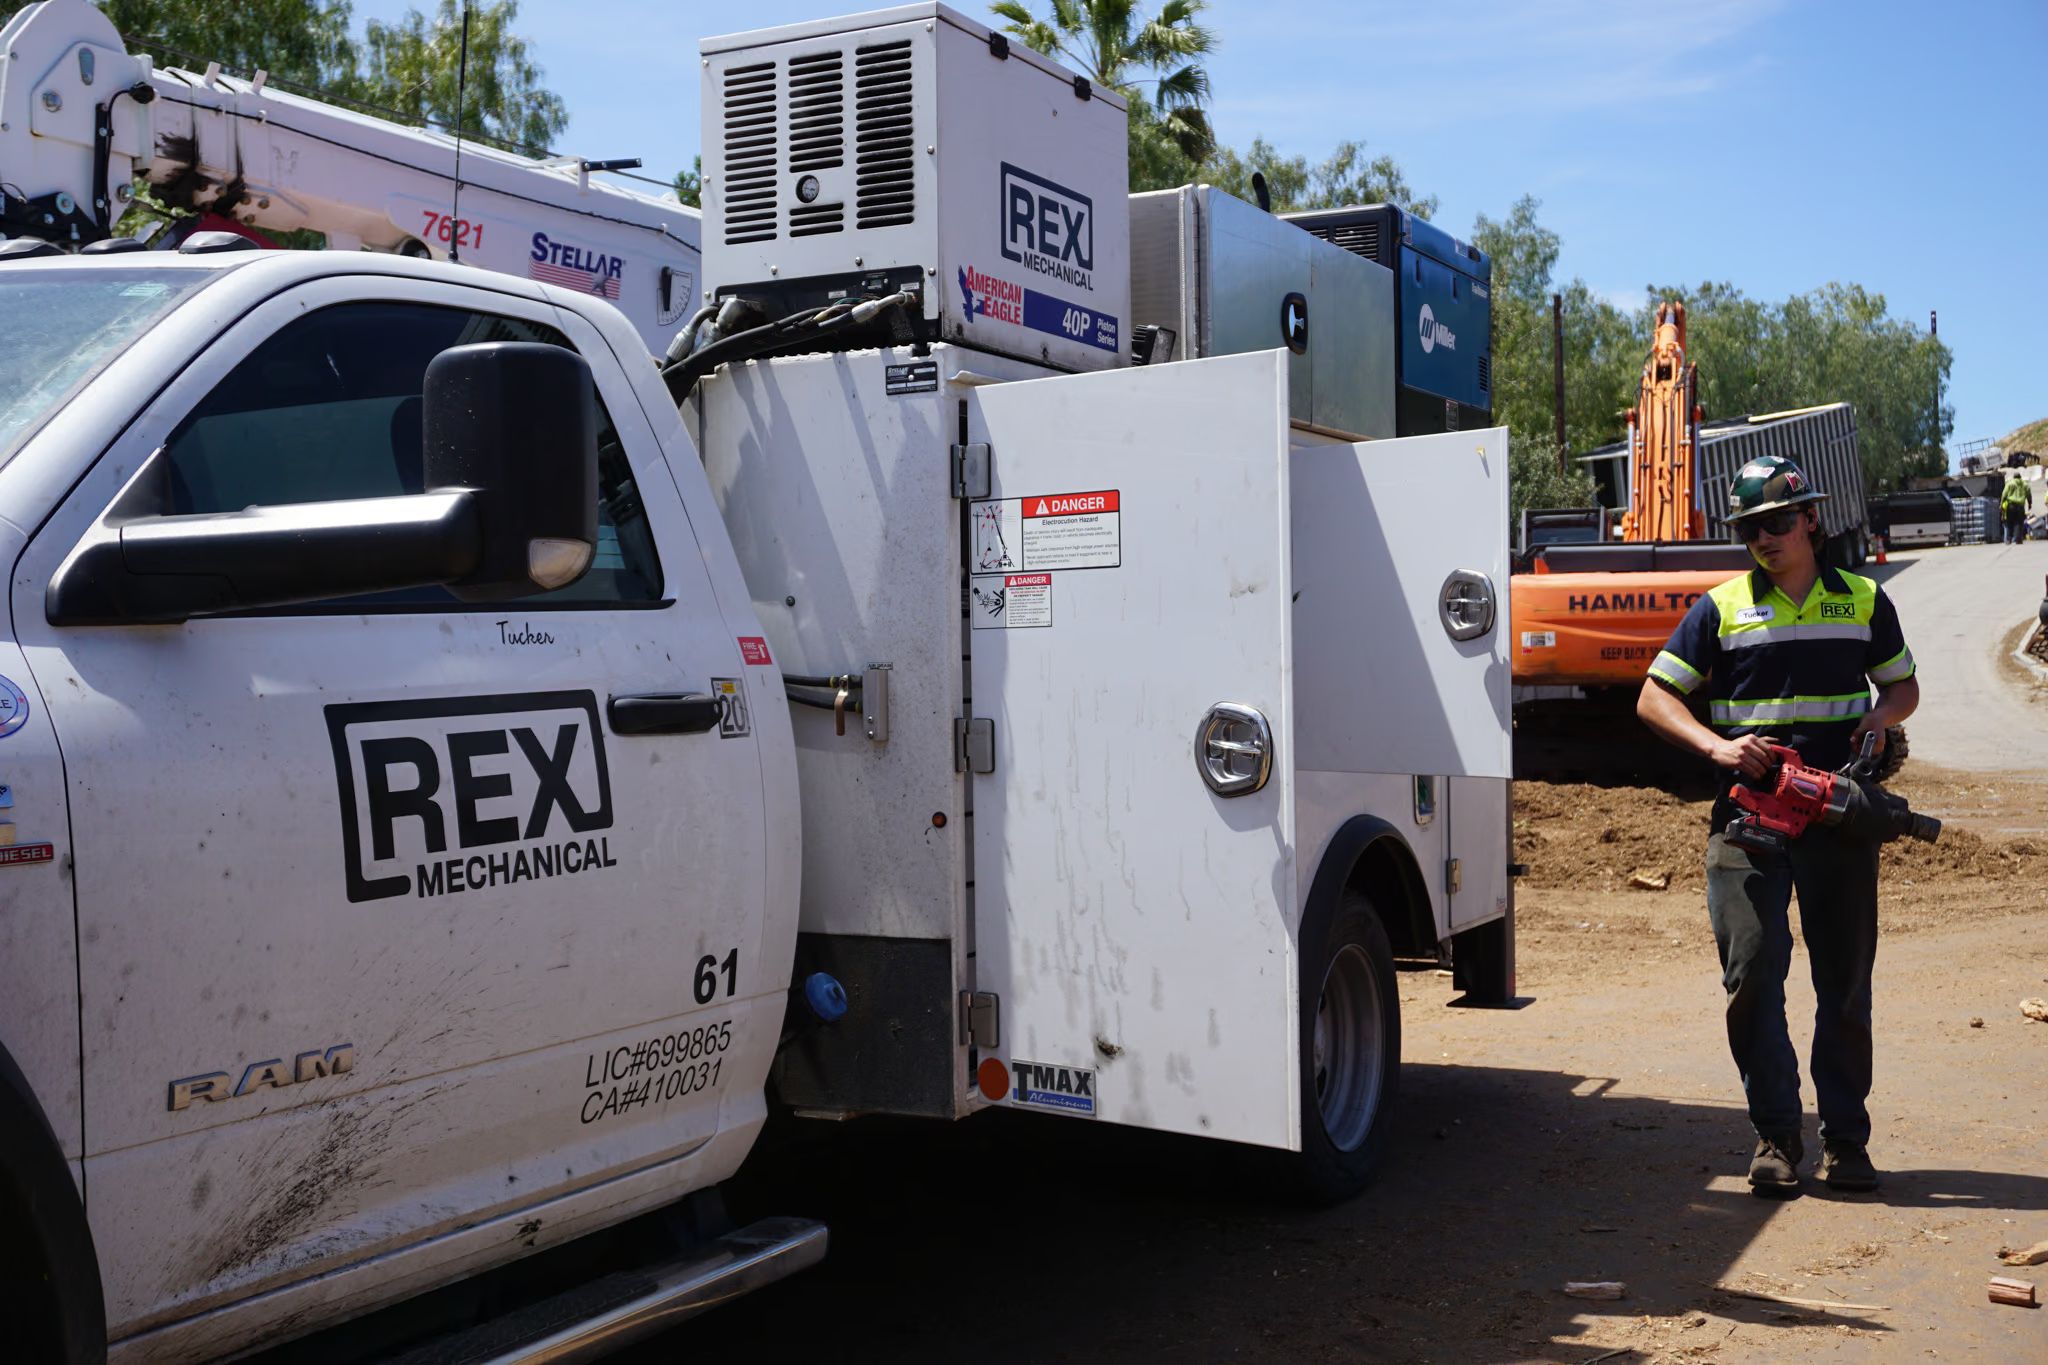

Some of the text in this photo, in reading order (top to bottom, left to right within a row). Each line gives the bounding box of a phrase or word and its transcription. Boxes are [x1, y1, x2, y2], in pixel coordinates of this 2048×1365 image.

[421, 211, 484, 249] 7621
[1009, 183, 1088, 264] REX
[531, 232, 623, 279] STELLAR
[966, 265, 1022, 305] AMERICAN
[1023, 251, 1094, 292] MECHANICAL
[984, 295, 1021, 326] EAGLE
[1062, 307, 1091, 337] 40P
[1097, 318, 1116, 334] Piston
[1097, 332, 1116, 347] Series
[1435, 321, 1457, 350] Miller
[1052, 496, 1105, 513] DANGER
[1042, 518, 1078, 526] Electrocution
[1017, 576, 1047, 585] DANGER
[1744, 611, 1769, 619] Tucker
[1823, 604, 1852, 616] REX
[496, 621, 555, 645] Tucker
[1601, 647, 1622, 659] KEEP
[1624, 647, 1647, 659] BACK
[360, 723, 586, 861] REX
[416, 837, 617, 898] MECHANICAL
[693, 948, 738, 1005] 61
[585, 1020, 733, 1088] LIC#699865
[168, 1043, 354, 1111] RAM
[579, 1057, 724, 1125] CA#410031
[1012, 1063, 1092, 1103] TMAX
[1028, 1093, 1092, 1110] Aluminum
